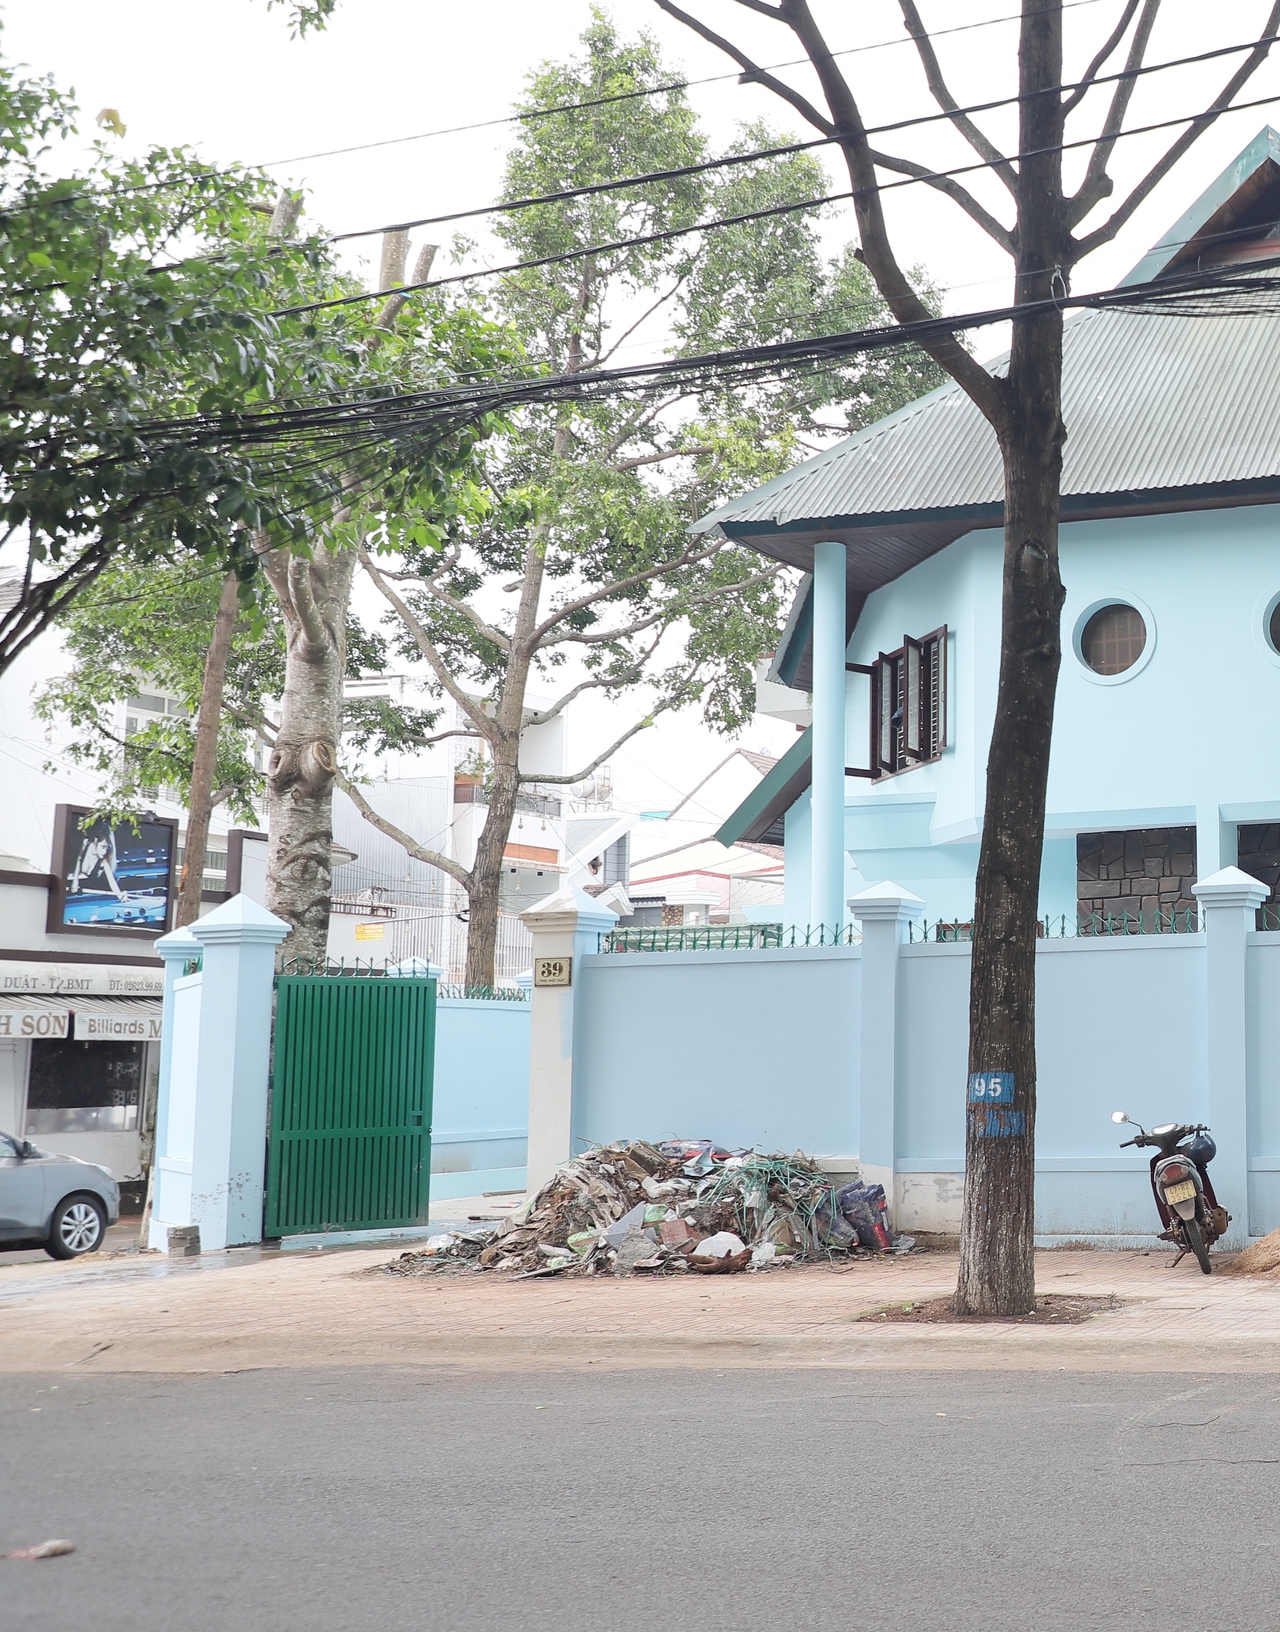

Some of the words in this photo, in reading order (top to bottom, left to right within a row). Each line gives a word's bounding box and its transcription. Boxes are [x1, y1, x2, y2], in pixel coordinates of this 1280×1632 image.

[541, 961, 564, 978] 39
[3, 974, 39, 991] DUẬT
[21, 1012, 67, 1036] SƠN
[88, 1018, 145, 1034] Billiards
[974, 1077, 1002, 1097] 95
